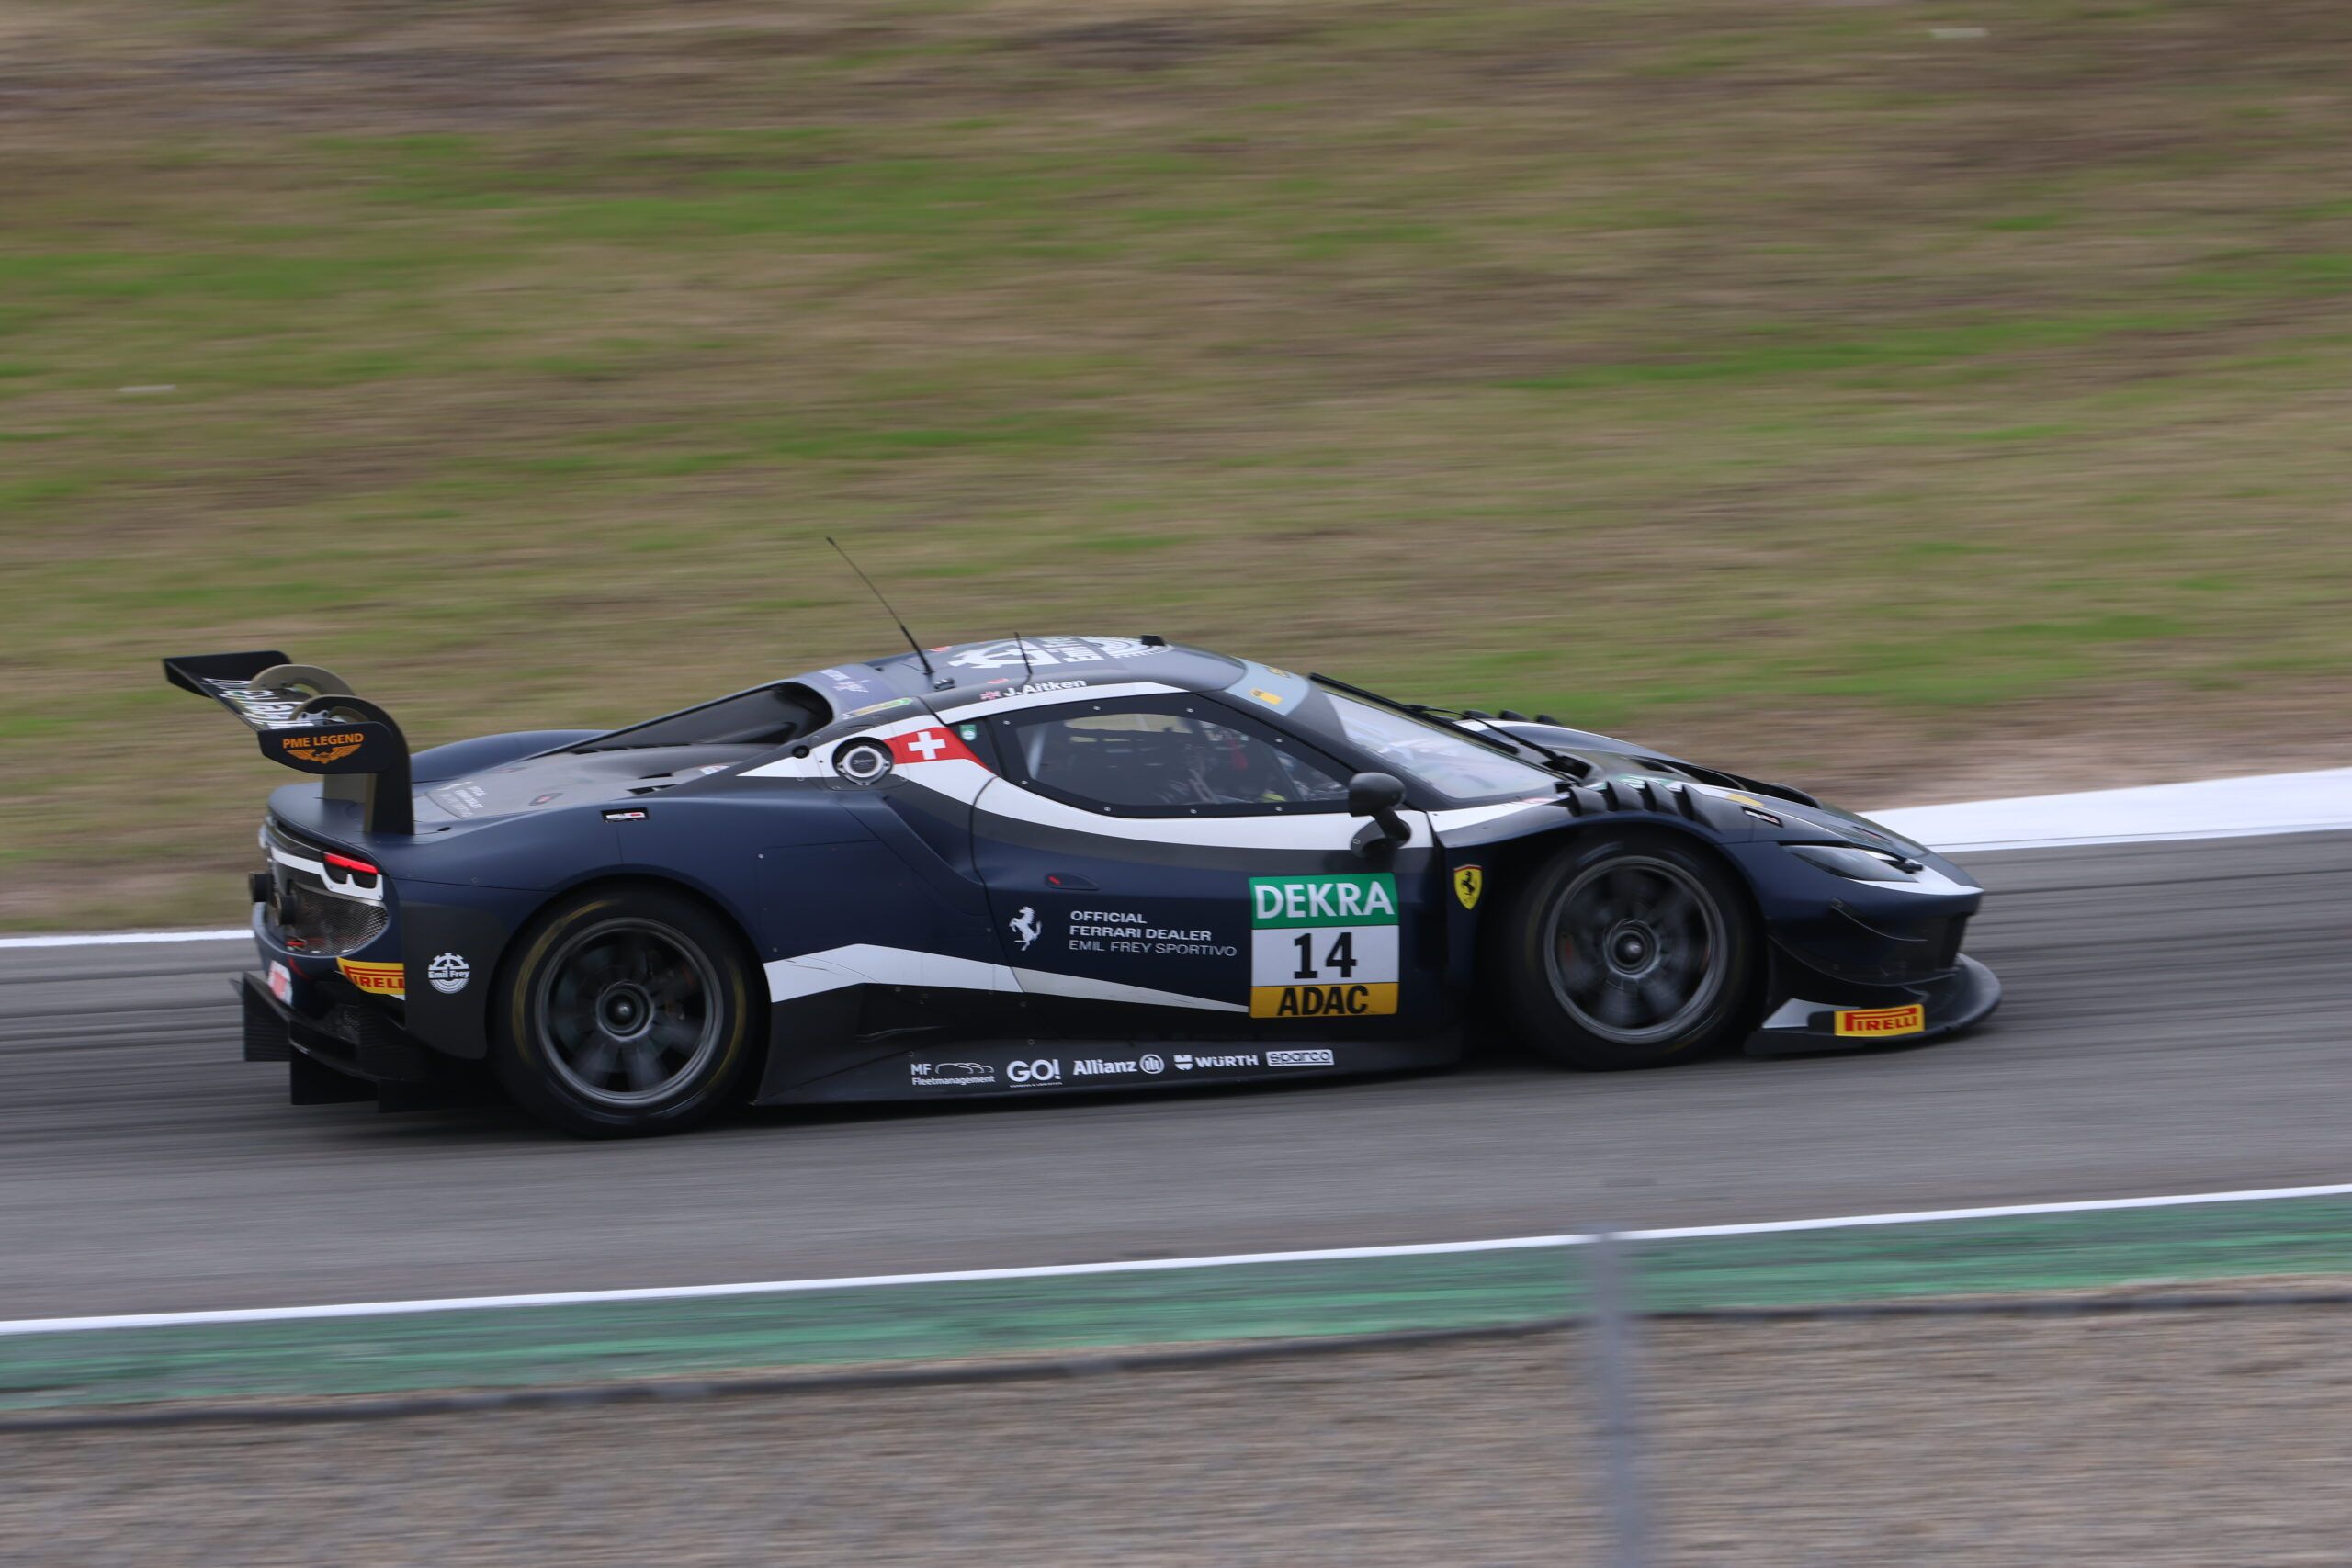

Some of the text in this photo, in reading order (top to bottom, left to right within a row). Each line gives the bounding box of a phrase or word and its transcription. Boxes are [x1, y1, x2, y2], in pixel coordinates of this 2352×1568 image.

[1003, 678, 1087, 697] J.Aitken
[282, 733, 365, 749] PME LEGEND
[1254, 881, 1395, 919] DEKRA
[1070, 910, 1148, 924] OFFICIAL
[1069, 925, 1212, 942] FERRARI DEALER
[1069, 940, 1238, 957] EMIL FREY SPORTIVO
[1294, 931, 1358, 979] 14
[428, 971, 470, 979] Emil Frey
[1277, 985, 1370, 1016] ADAC
[1845, 1007, 1918, 1031] PIRELLI
[1269, 1051, 1332, 1063] sparco
[910, 1063, 932, 1076] MF
[1006, 1059, 1062, 1082] GO!
[1073, 1060, 1137, 1076] Allianz
[911, 1075, 996, 1086] Fleetmanagement
